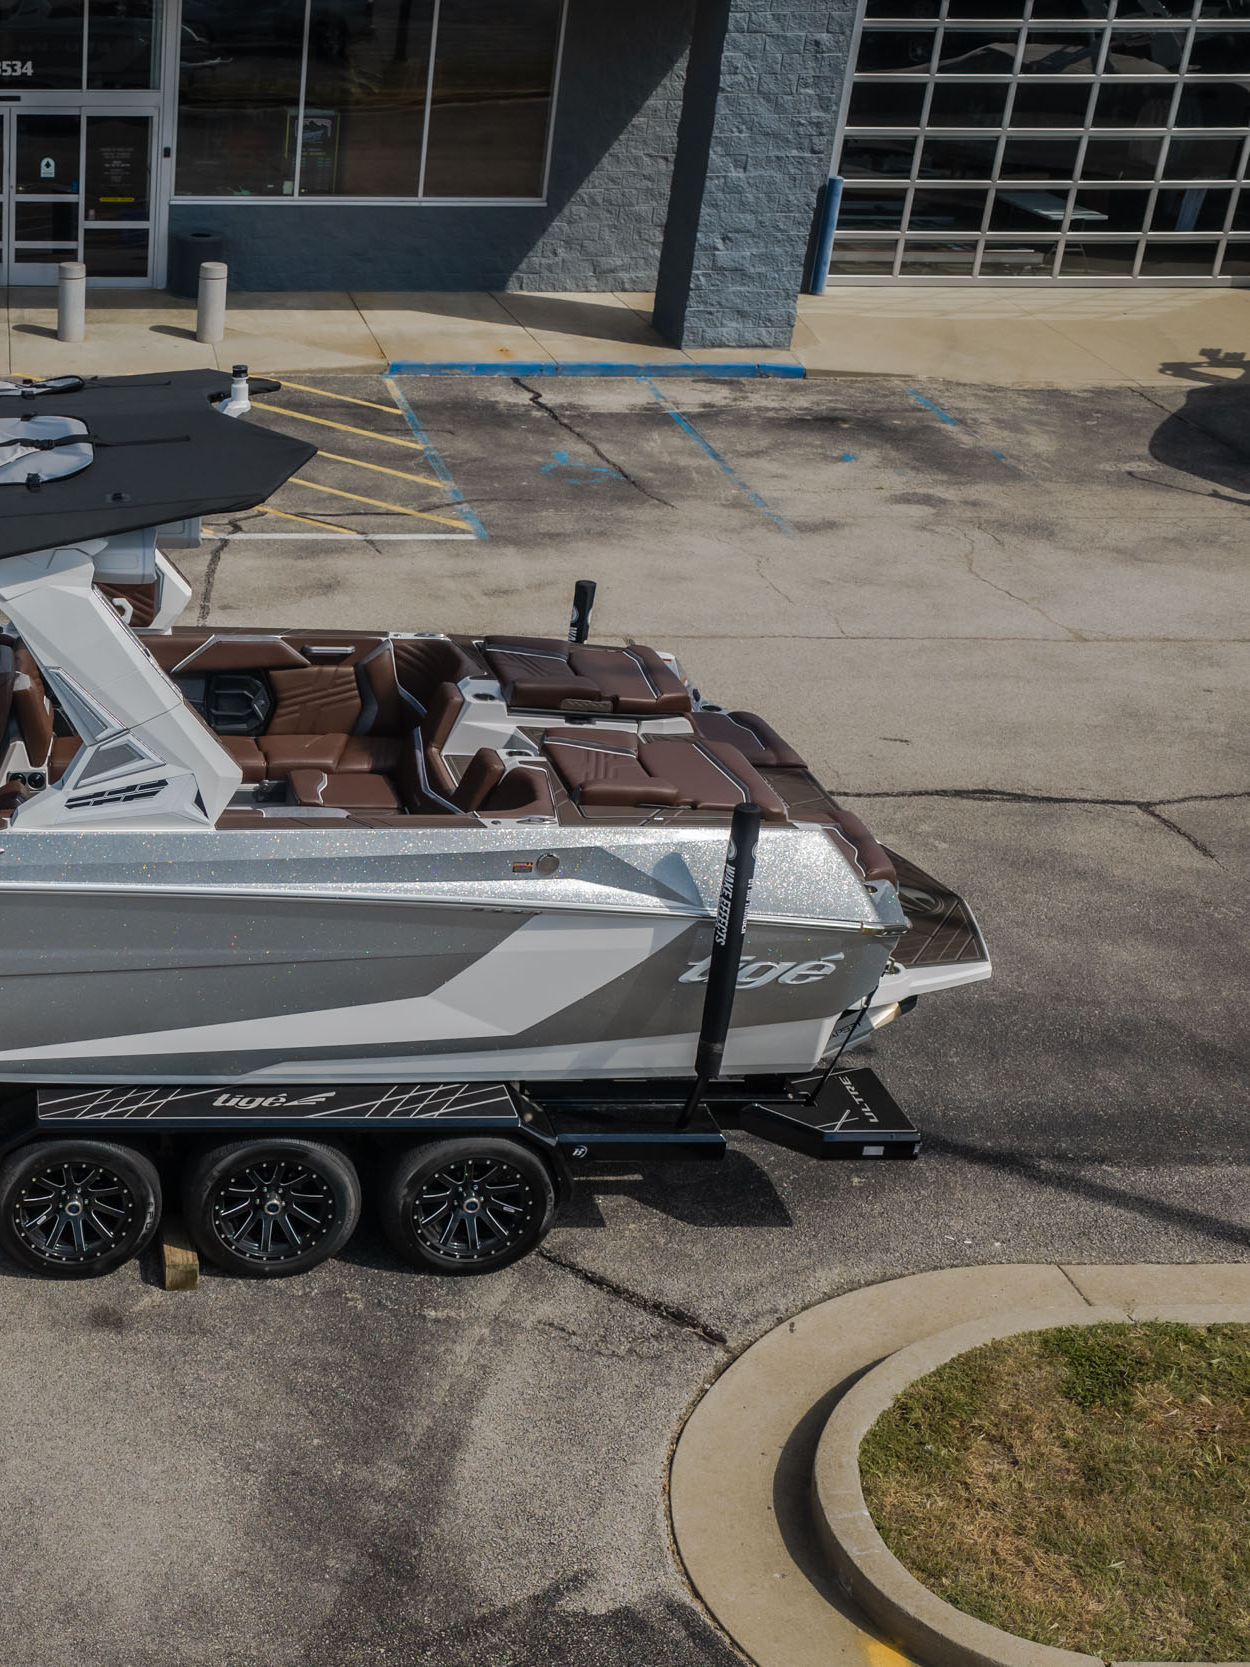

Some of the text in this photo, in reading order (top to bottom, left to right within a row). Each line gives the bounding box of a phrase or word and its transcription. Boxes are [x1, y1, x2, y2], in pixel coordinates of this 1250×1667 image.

[715, 863, 736, 946] WAKE EFFECTS
[212, 1092, 288, 1110] tigé
